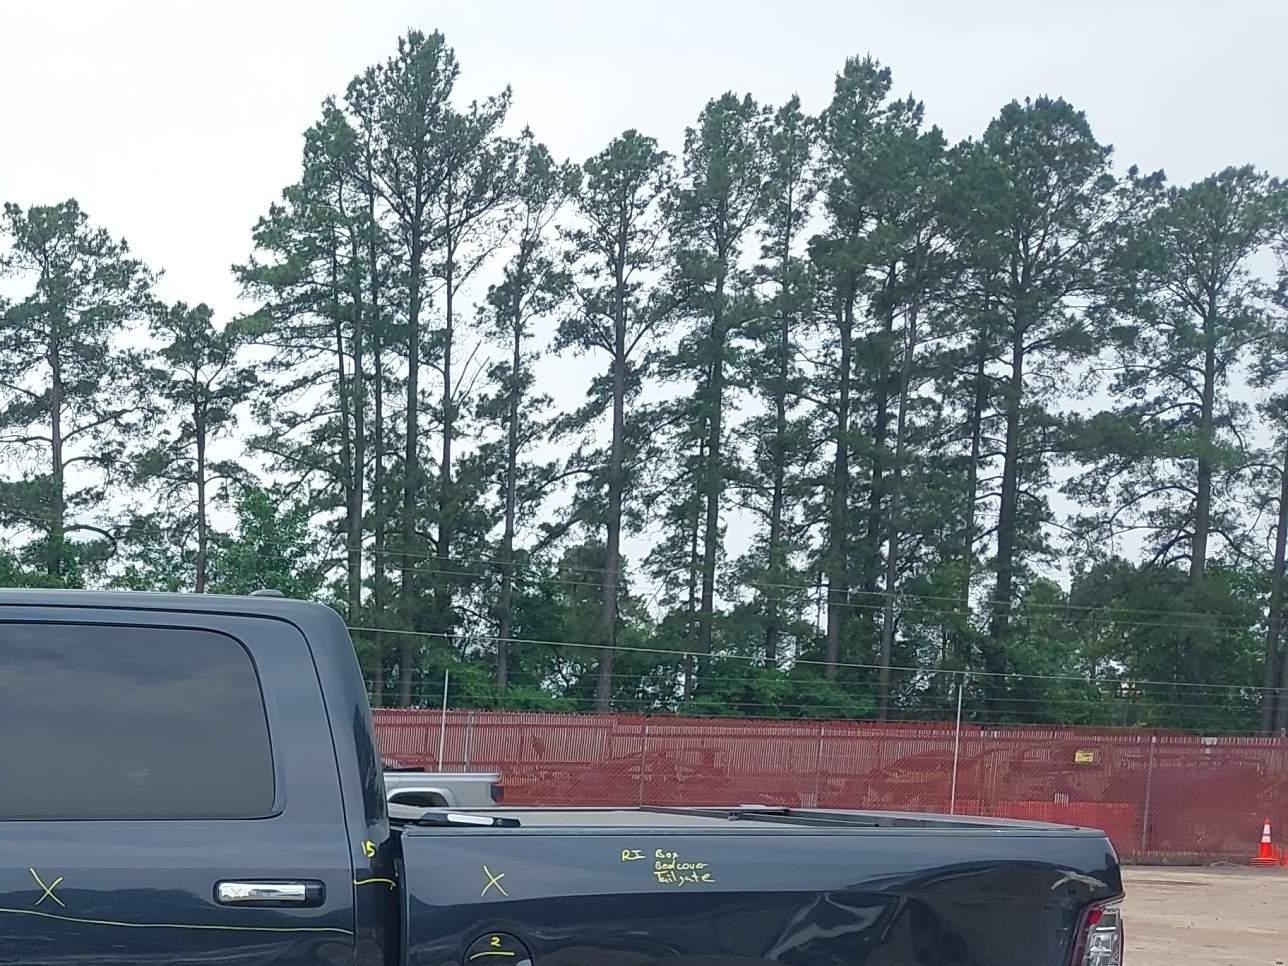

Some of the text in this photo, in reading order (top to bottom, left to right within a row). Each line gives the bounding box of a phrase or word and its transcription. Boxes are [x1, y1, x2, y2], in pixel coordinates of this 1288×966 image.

[655, 848, 680, 860] Box
[653, 871, 716, 887] Tailgate
[490, 936, 502, 948] 2
